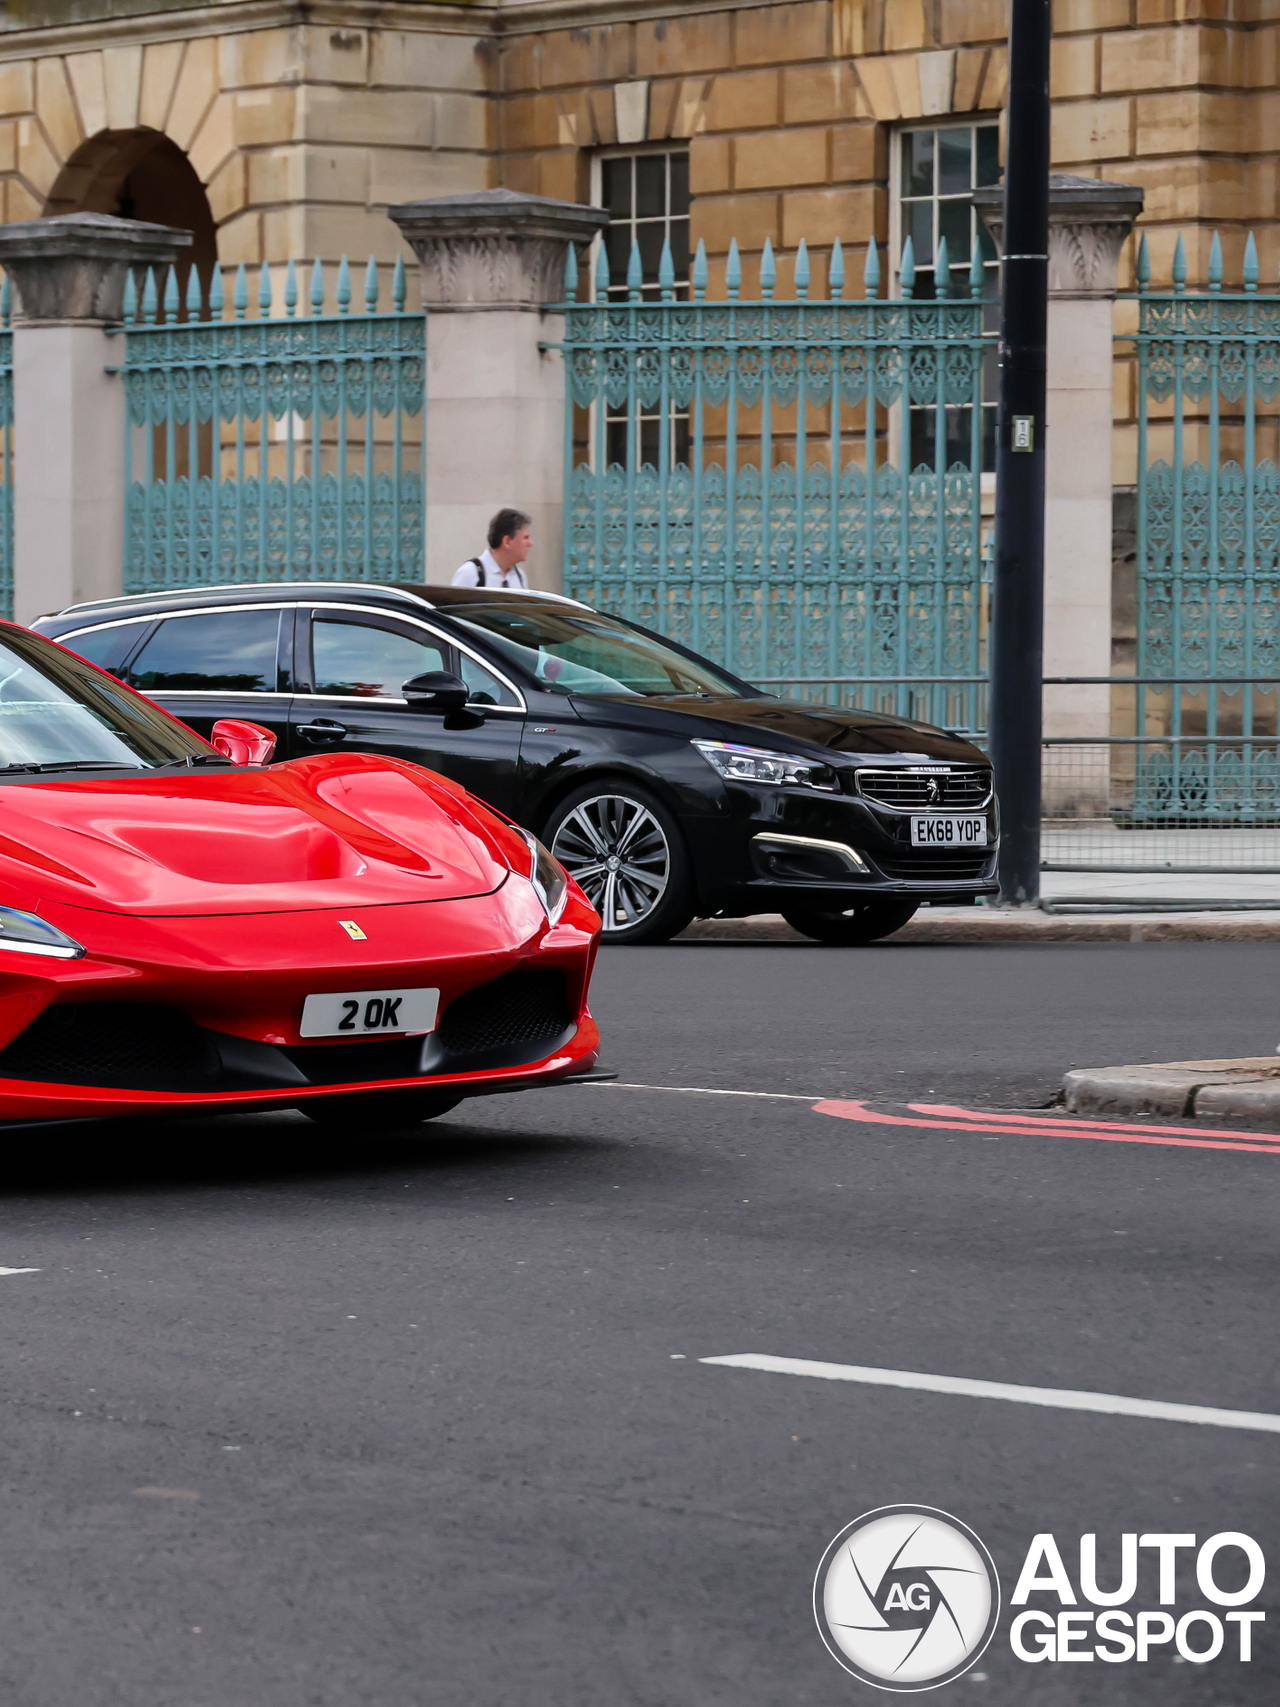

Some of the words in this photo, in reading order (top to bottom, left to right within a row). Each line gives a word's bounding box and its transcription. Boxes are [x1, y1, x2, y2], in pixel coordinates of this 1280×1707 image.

[918, 820, 953, 842] EK68
[957, 820, 981, 842] YOP
[338, 1000, 359, 1030] 2
[364, 997, 403, 1028] OK
